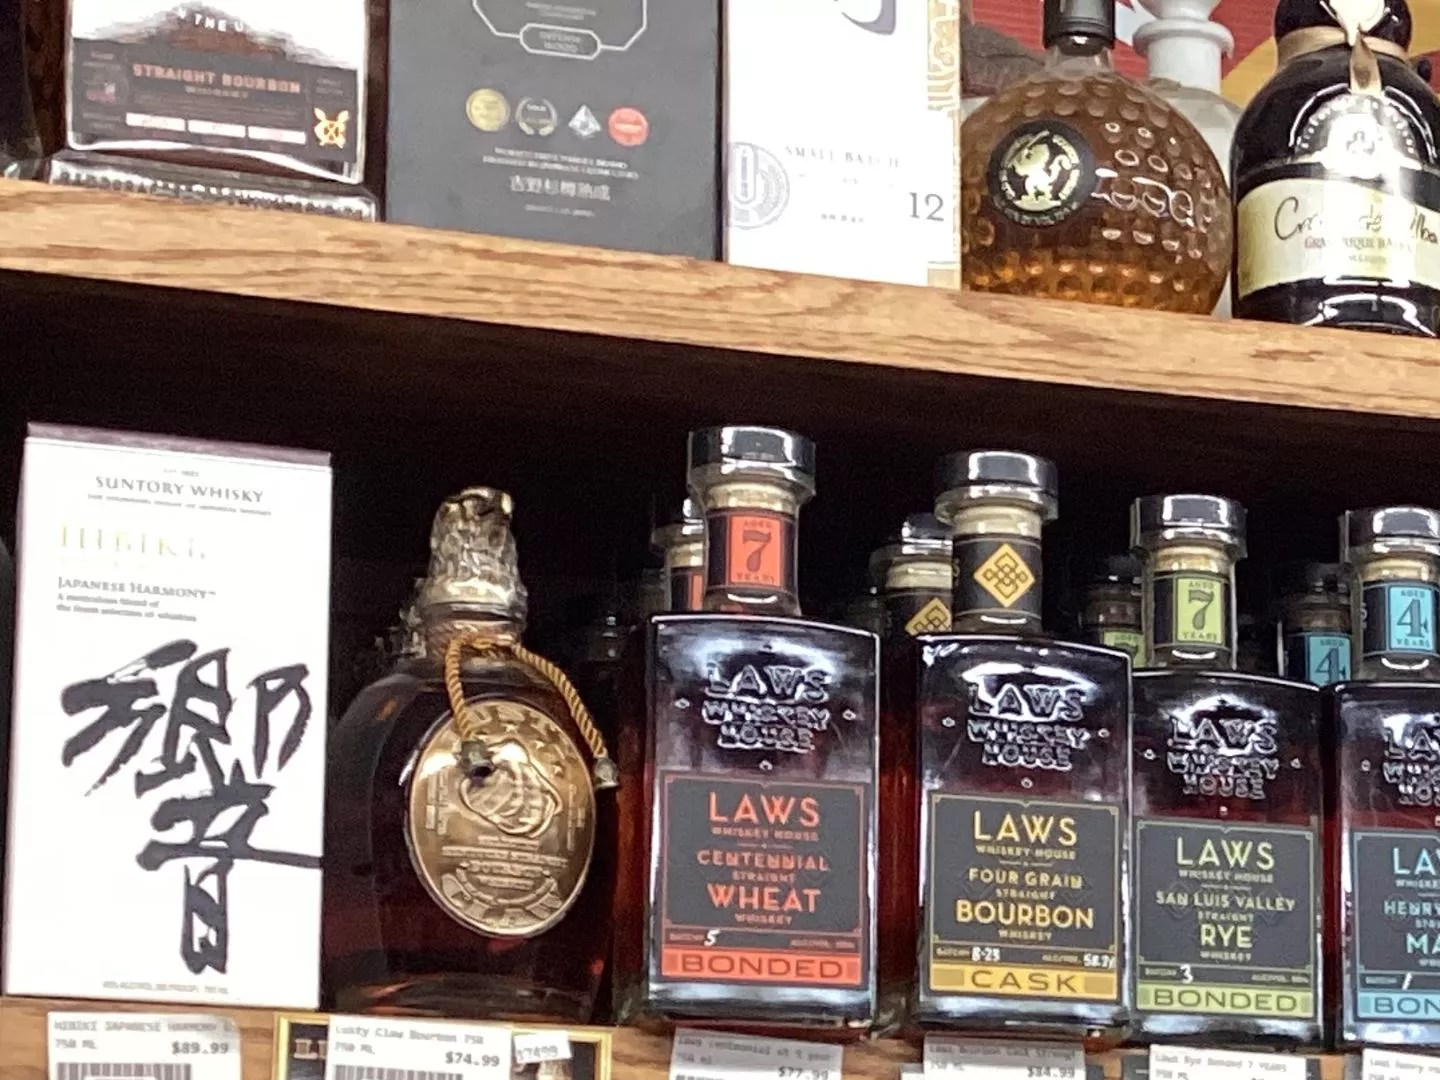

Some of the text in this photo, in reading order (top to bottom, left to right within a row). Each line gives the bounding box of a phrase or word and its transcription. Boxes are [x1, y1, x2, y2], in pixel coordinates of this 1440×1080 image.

[132, 64, 300, 93] STRAIGHT BOURBON
[908, 192, 944, 221] 12
[96, 476, 263, 502] SUNTORY WHISKY
[742, 530, 772, 573] 7
[58, 577, 125, 592] JAPANESE
[1188, 590, 1215, 630] 7
[1398, 598, 1428, 638] 4
[1315, 648, 1346, 683] 4
[709, 791, 820, 827] LAWS
[973, 809, 1077, 847] LAWS
[697, 849, 830, 872] CENTENNIAL
[1176, 837, 1275, 870] LAWS
[969, 867, 1083, 889] FOUR GRAIN
[708, 883, 821, 914] WHEAT
[1156, 891, 1295, 911] SAN LUIS VALLEY
[956, 899, 1094, 929] BOURBON
[1201, 923, 1253, 948] RYE
[681, 953, 843, 979] BONDED
[1179, 965, 1193, 984] 3
[970, 970, 1078, 993] CASK
[1153, 988, 1297, 1013] BONDED
[172, 1041, 229, 1055] $89.99
[445, 1052, 500, 1067] $74.99
